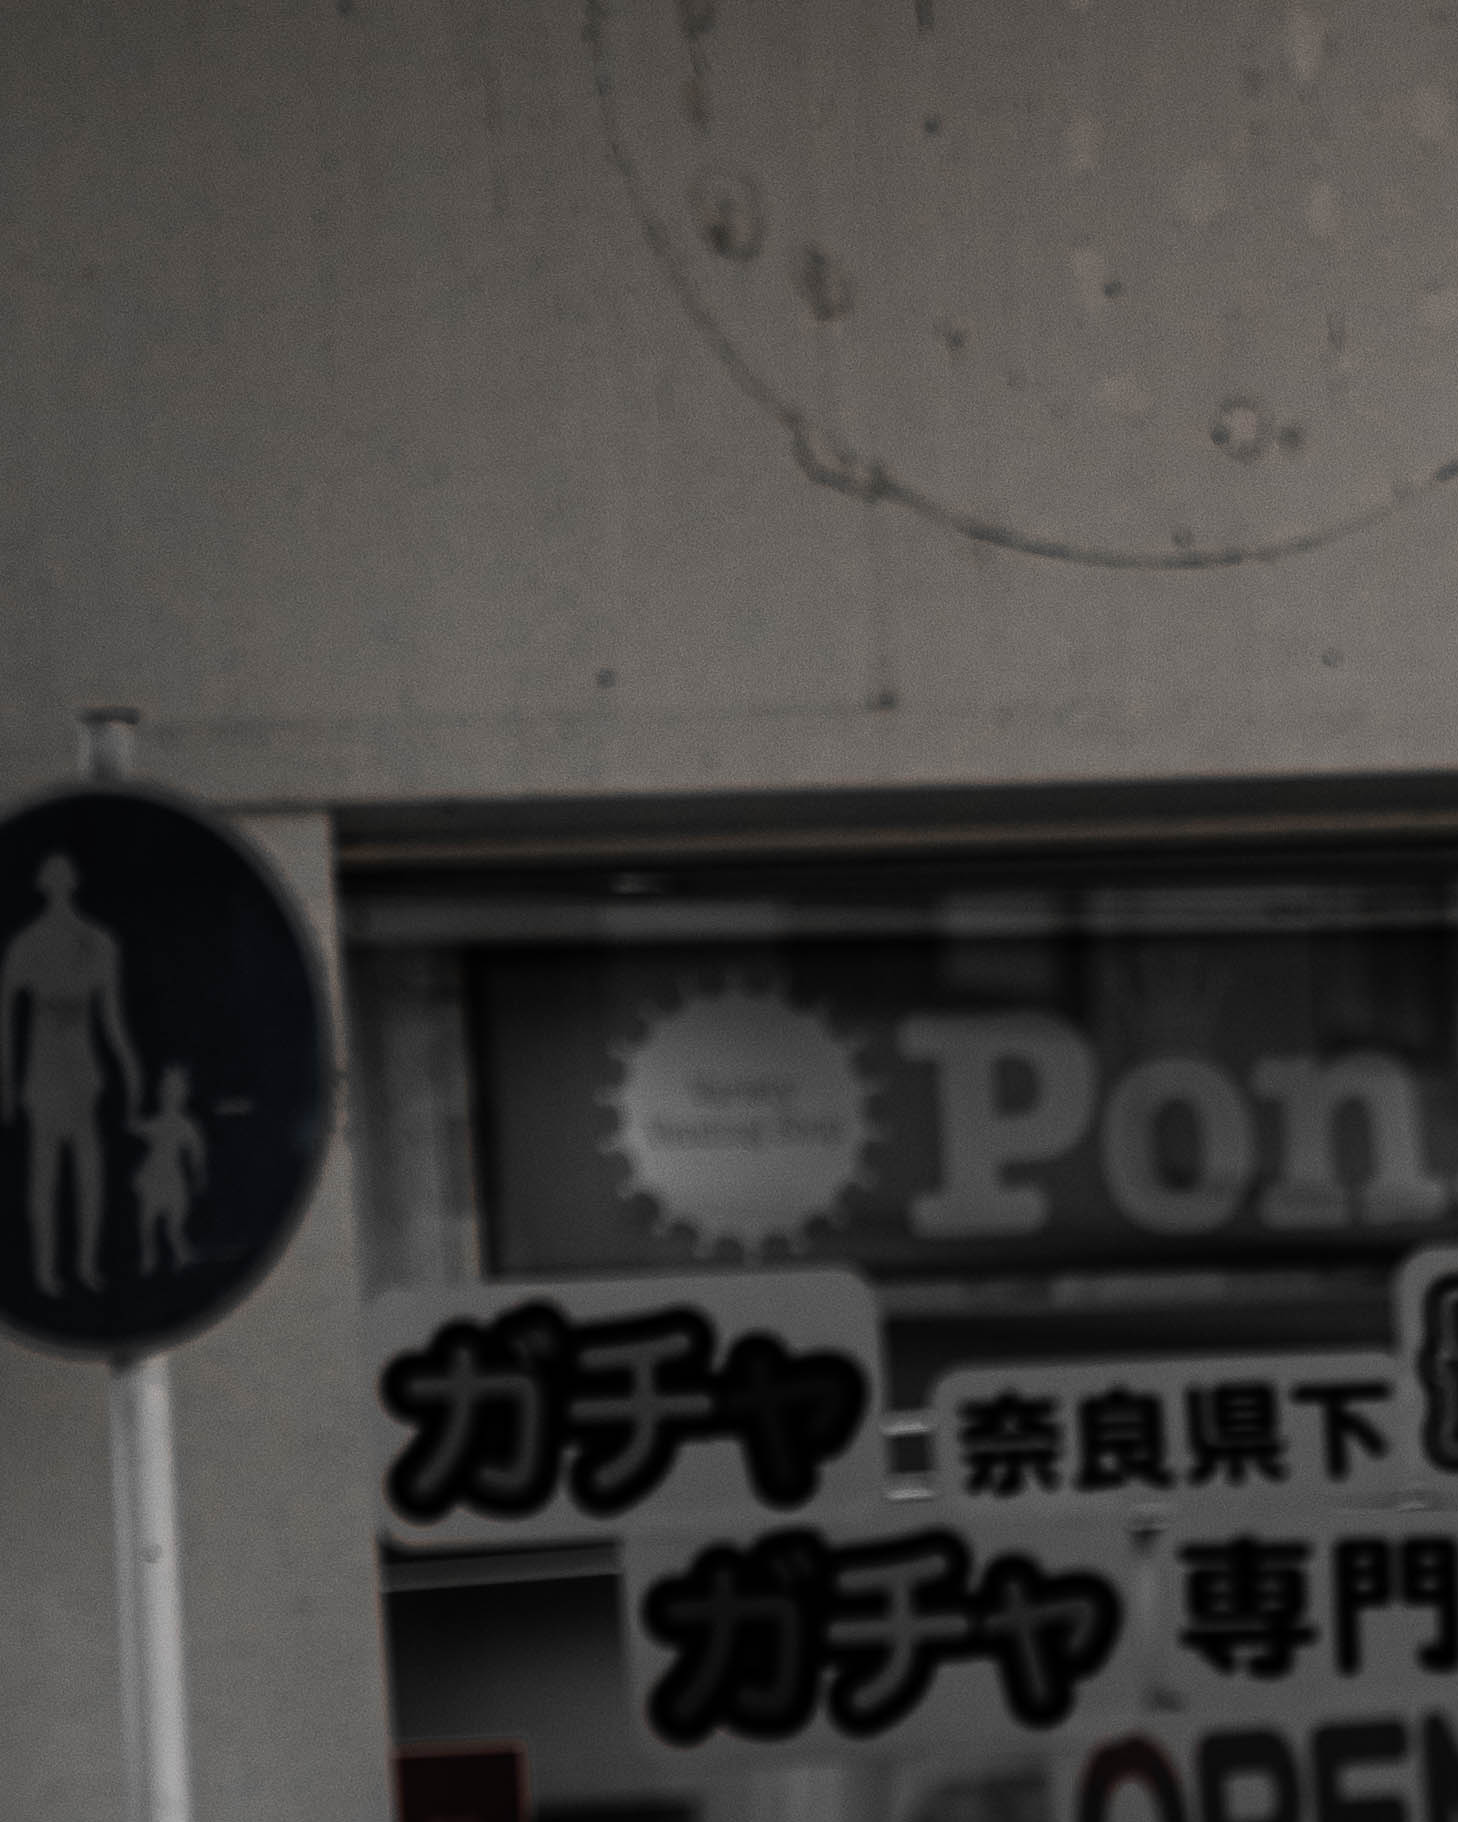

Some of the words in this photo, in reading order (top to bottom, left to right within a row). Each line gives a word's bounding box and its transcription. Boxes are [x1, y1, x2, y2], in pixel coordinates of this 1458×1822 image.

[381, 1300, 866, 1522] ガチャ
[959, 1382, 1391, 1495] 奈良県下
[647, 1528, 1116, 1743] ガチャ
